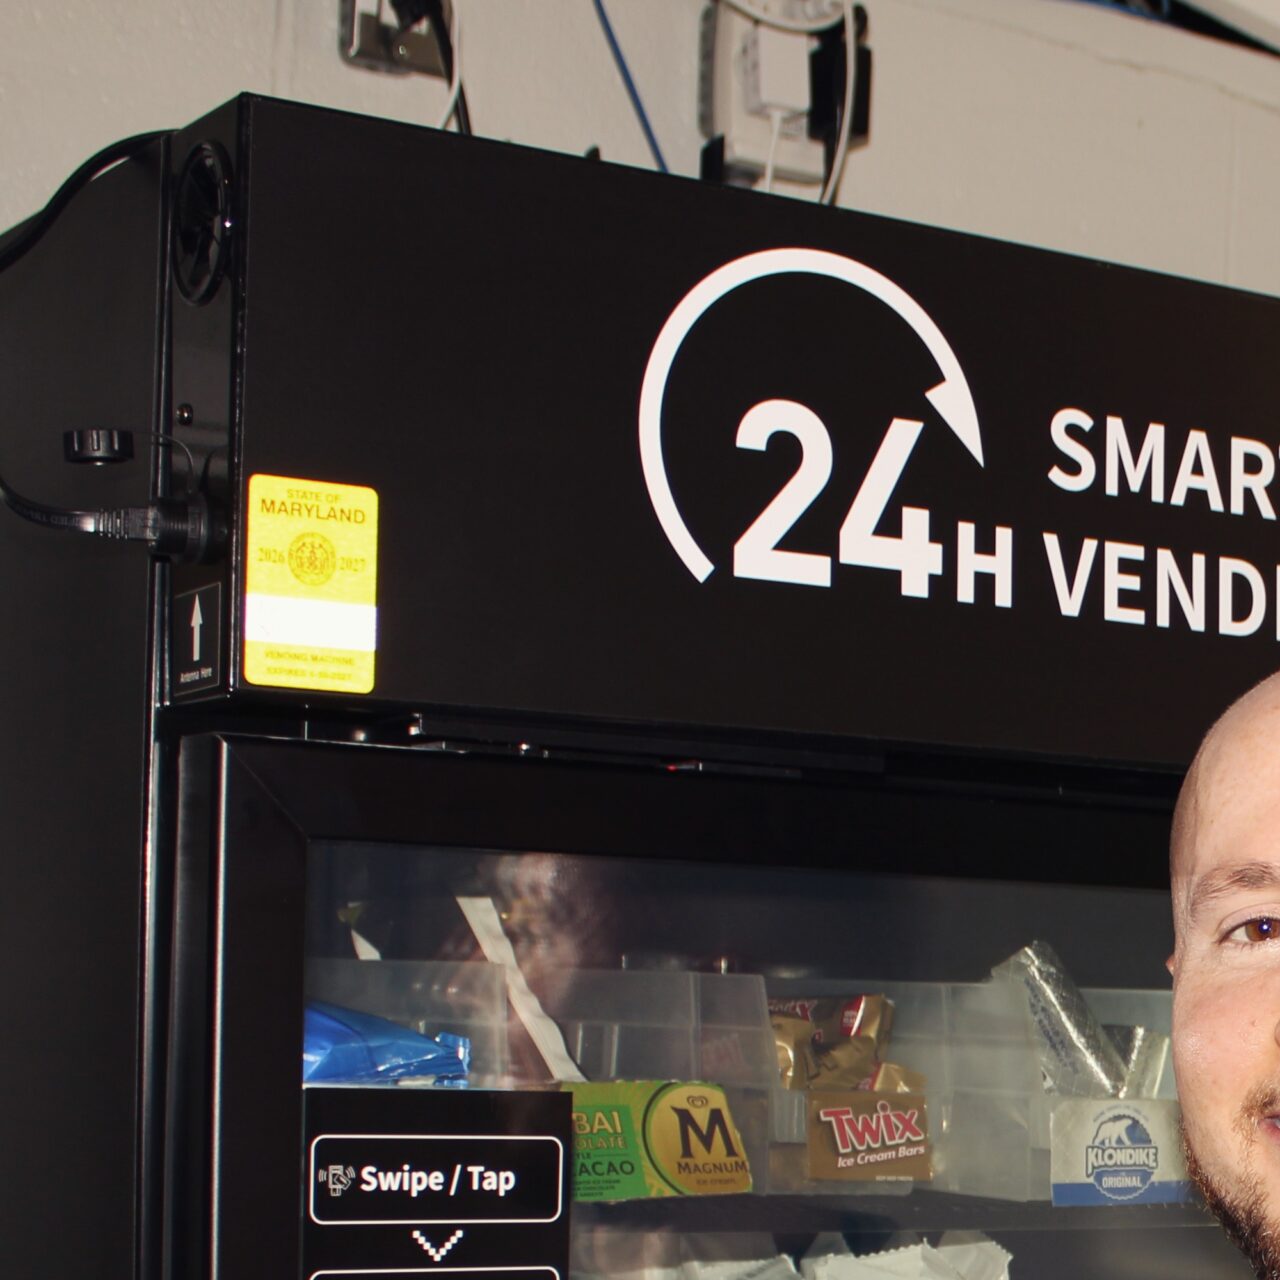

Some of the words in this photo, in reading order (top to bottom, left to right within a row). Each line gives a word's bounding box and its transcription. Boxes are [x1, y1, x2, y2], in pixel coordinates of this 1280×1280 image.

[286, 488, 322, 501] STATE
[324, 492, 342, 504] OF
[260, 498, 367, 525] MARYLAND
[257, 547, 286, 564] 2026
[338, 556, 367, 573] 2027
[820, 1100, 924, 1154] Twix
[573, 1160, 636, 1177] ACAO
[677, 1160, 748, 1175] MAGNUM
[837, 1156, 855, 1168] Ice
[857, 1150, 896, 1165] Cream
[899, 1144, 925, 1158] Bars
[1087, 1147, 1158, 1176] KLONDIKE
[360, 1164, 444, 1197] Swipe
[449, 1164, 462, 1196] /
[467, 1165, 516, 1197] Tap
[1102, 1176, 1142, 1188] ORIGINAL
